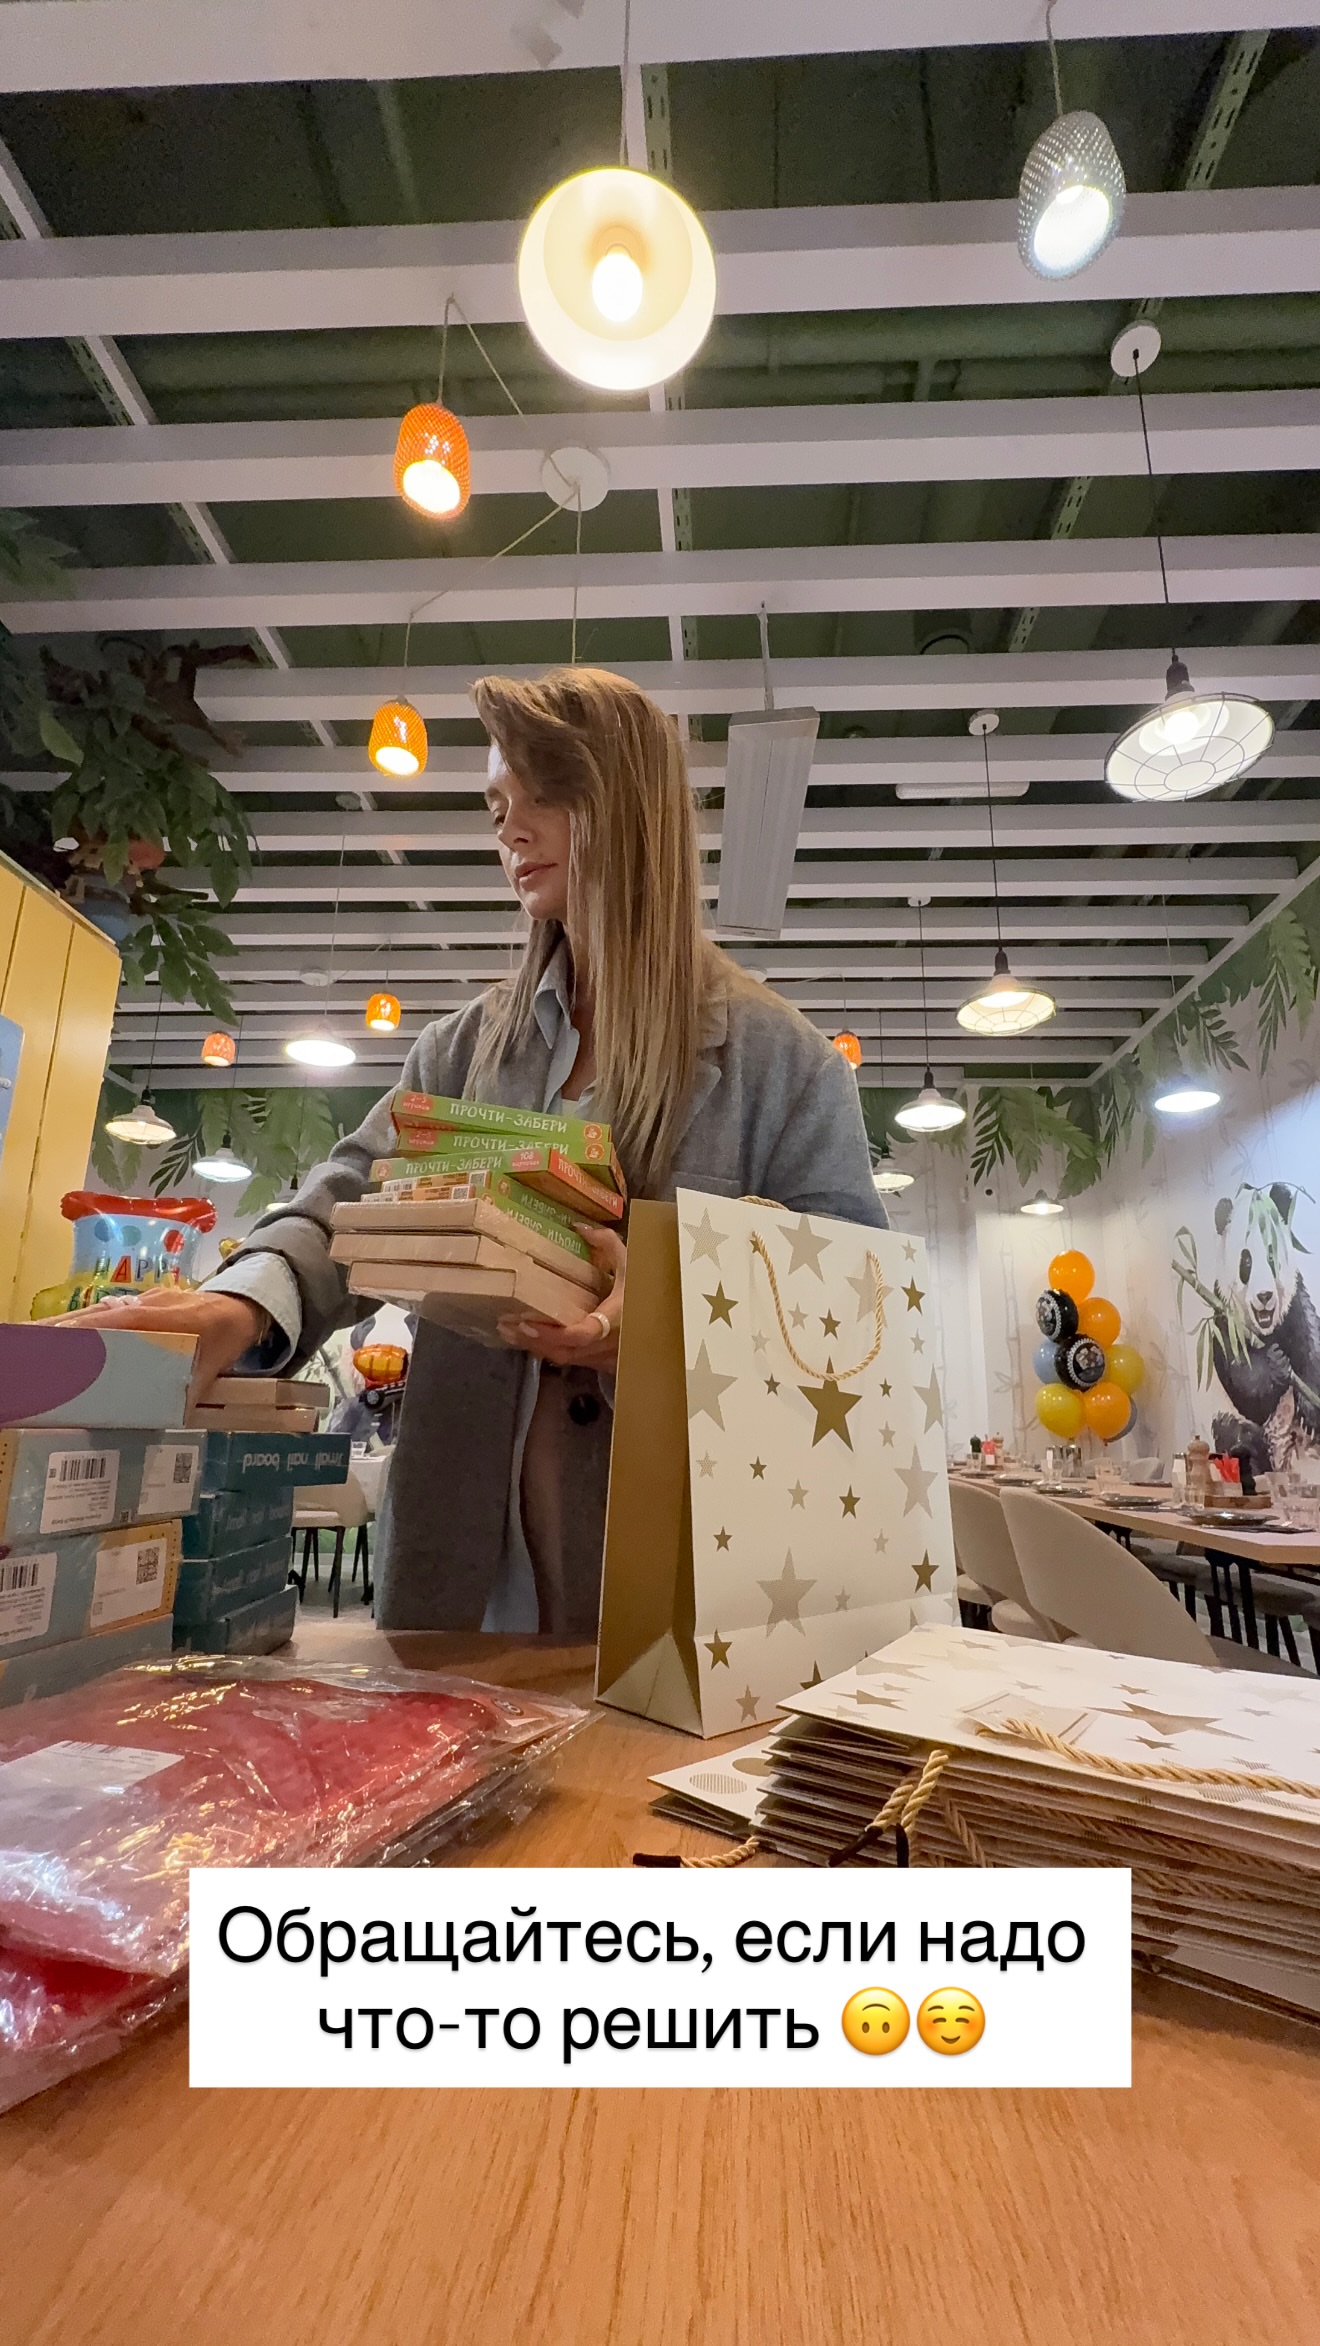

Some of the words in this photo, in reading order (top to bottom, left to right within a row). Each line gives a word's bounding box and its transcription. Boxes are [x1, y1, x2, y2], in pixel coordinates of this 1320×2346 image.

[450, 1103, 568, 1133] ПРОЧТИ-ЗАБЕРИ
[406, 1156, 502, 1174] ПРОЧТИ-ЗАБЕРИ
[94, 1255, 180, 1285] HAPPY
[242, 1453, 280, 1473] board
